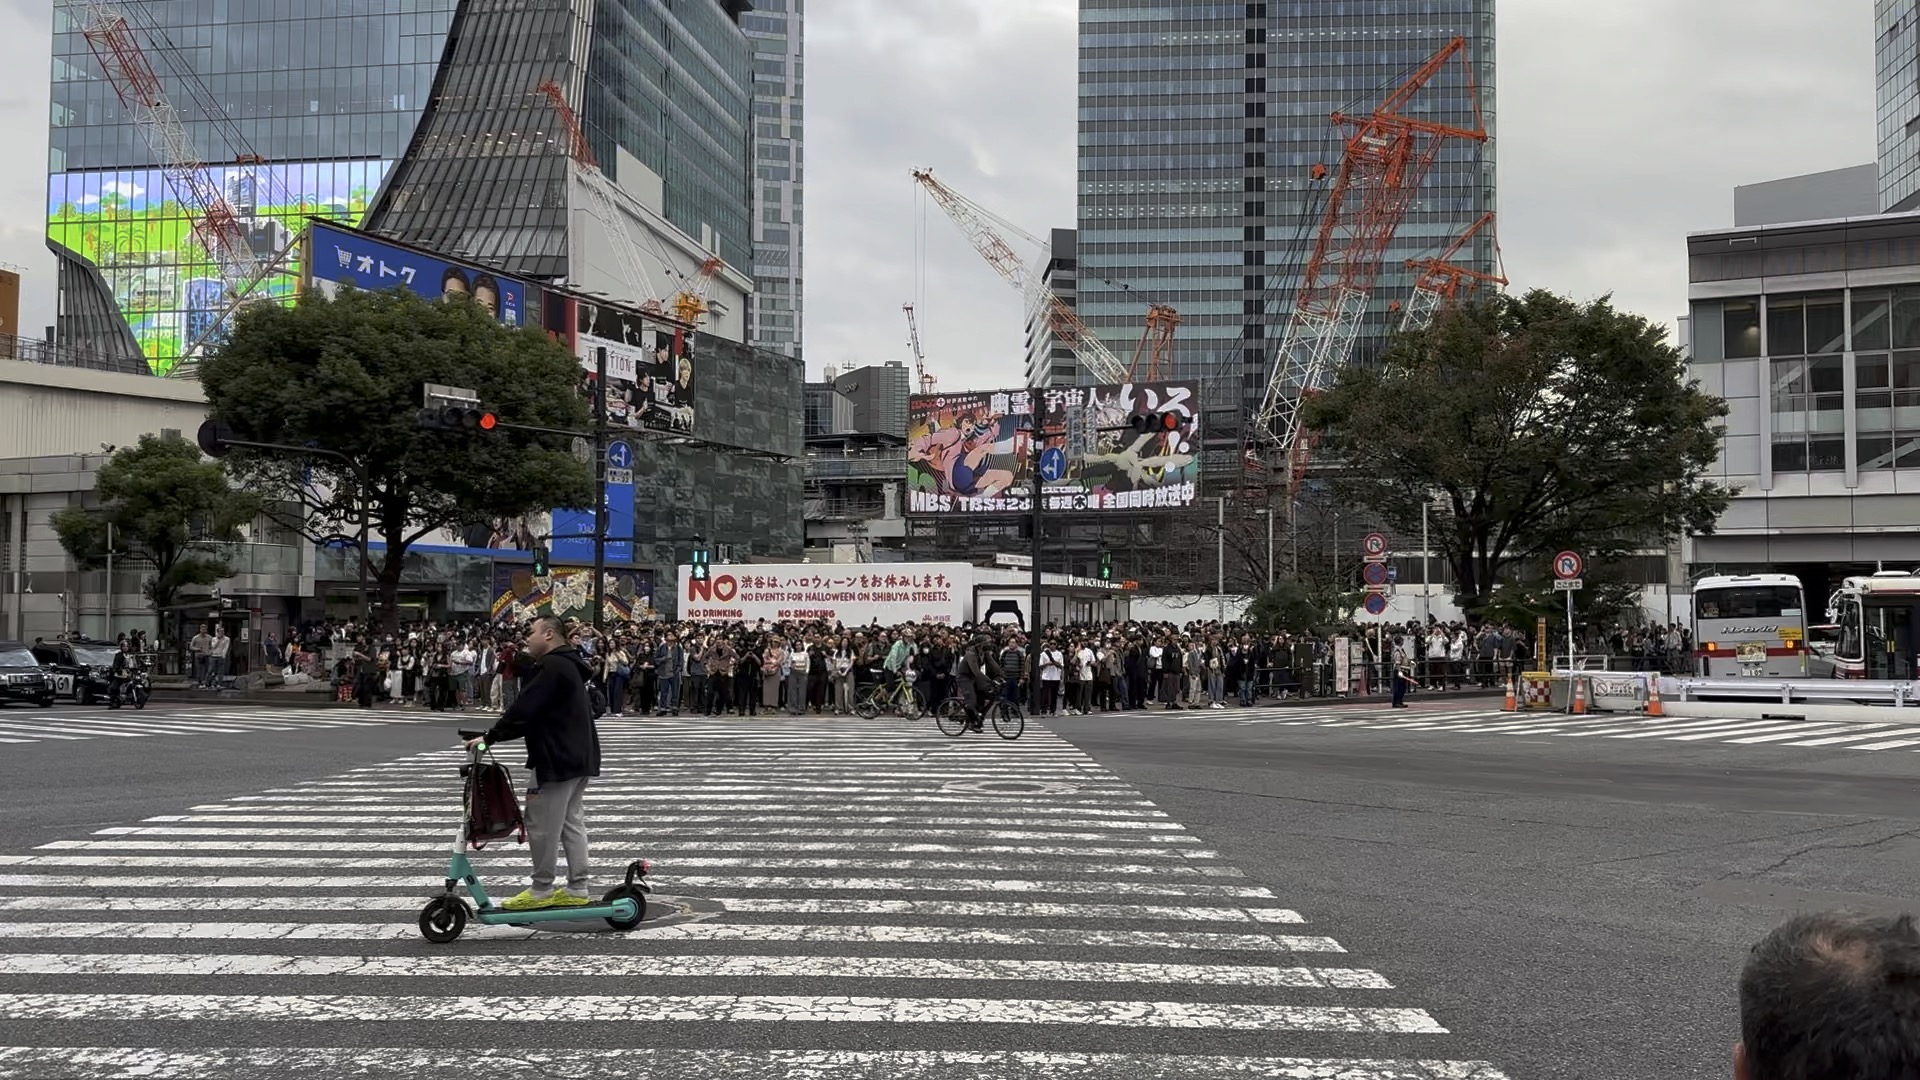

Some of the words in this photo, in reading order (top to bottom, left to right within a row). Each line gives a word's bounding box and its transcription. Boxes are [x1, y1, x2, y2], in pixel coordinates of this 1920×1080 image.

[357, 256, 416, 284] オトク
[741, 574, 951, 589] 渋谷は、ハロウィーンをお休みします。
[688, 575, 737, 602] NO
[740, 591, 754, 602] NO
[754, 591, 785, 602] EVENTS
[786, 591, 803, 602] FOR
[805, 591, 856, 602] HALLOWEEN
[857, 591, 870, 602] ON
[872, 591, 910, 602] SHIBUYA
[912, 591, 951, 602] STREETS.
[688, 609, 700, 618] NO
[702, 609, 743, 618] DRINKING
[778, 609, 791, 618] NO
[794, 609, 836, 618] SMOKING
[1721, 625, 1778, 634] Hybrid
